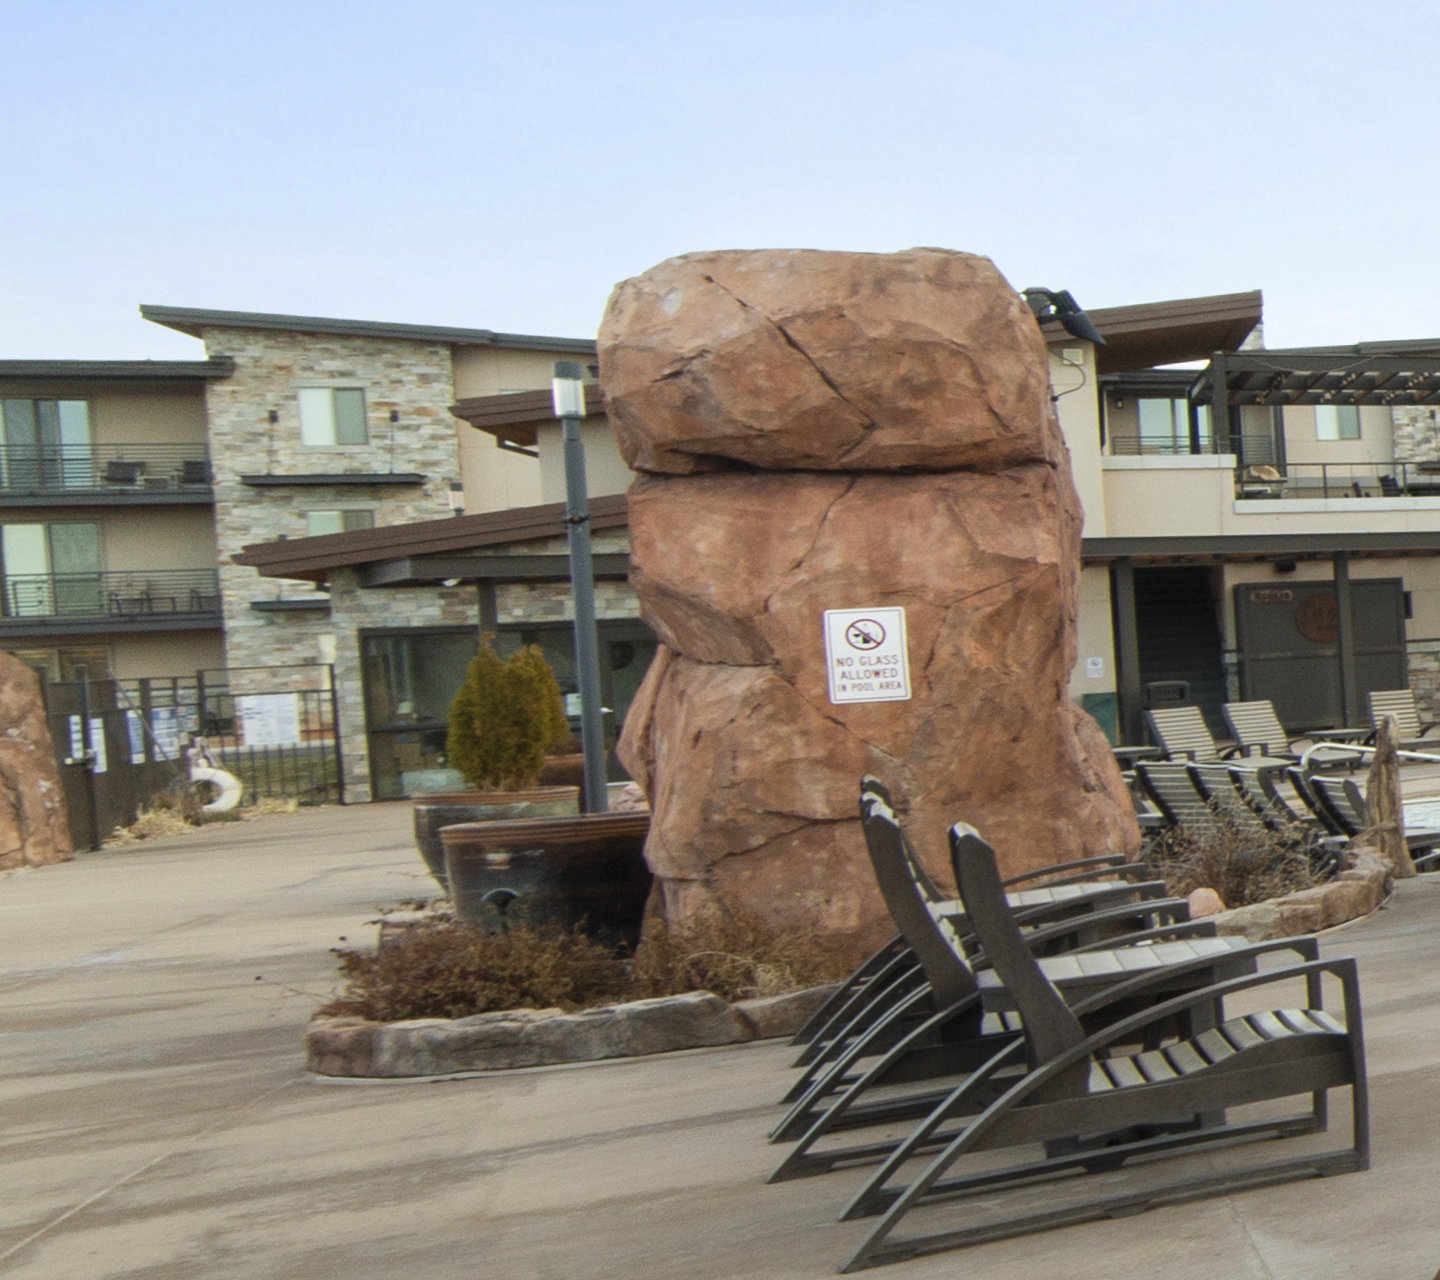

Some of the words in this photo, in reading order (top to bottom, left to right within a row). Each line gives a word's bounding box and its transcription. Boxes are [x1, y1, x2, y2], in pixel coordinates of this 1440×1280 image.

[836, 657, 854, 667] NO
[859, 654, 899, 666] GLASS
[840, 668, 898, 680] ALLOWED
[837, 684, 847, 692] IN
[852, 683, 875, 692] POOL
[879, 681, 902, 690] AREA
